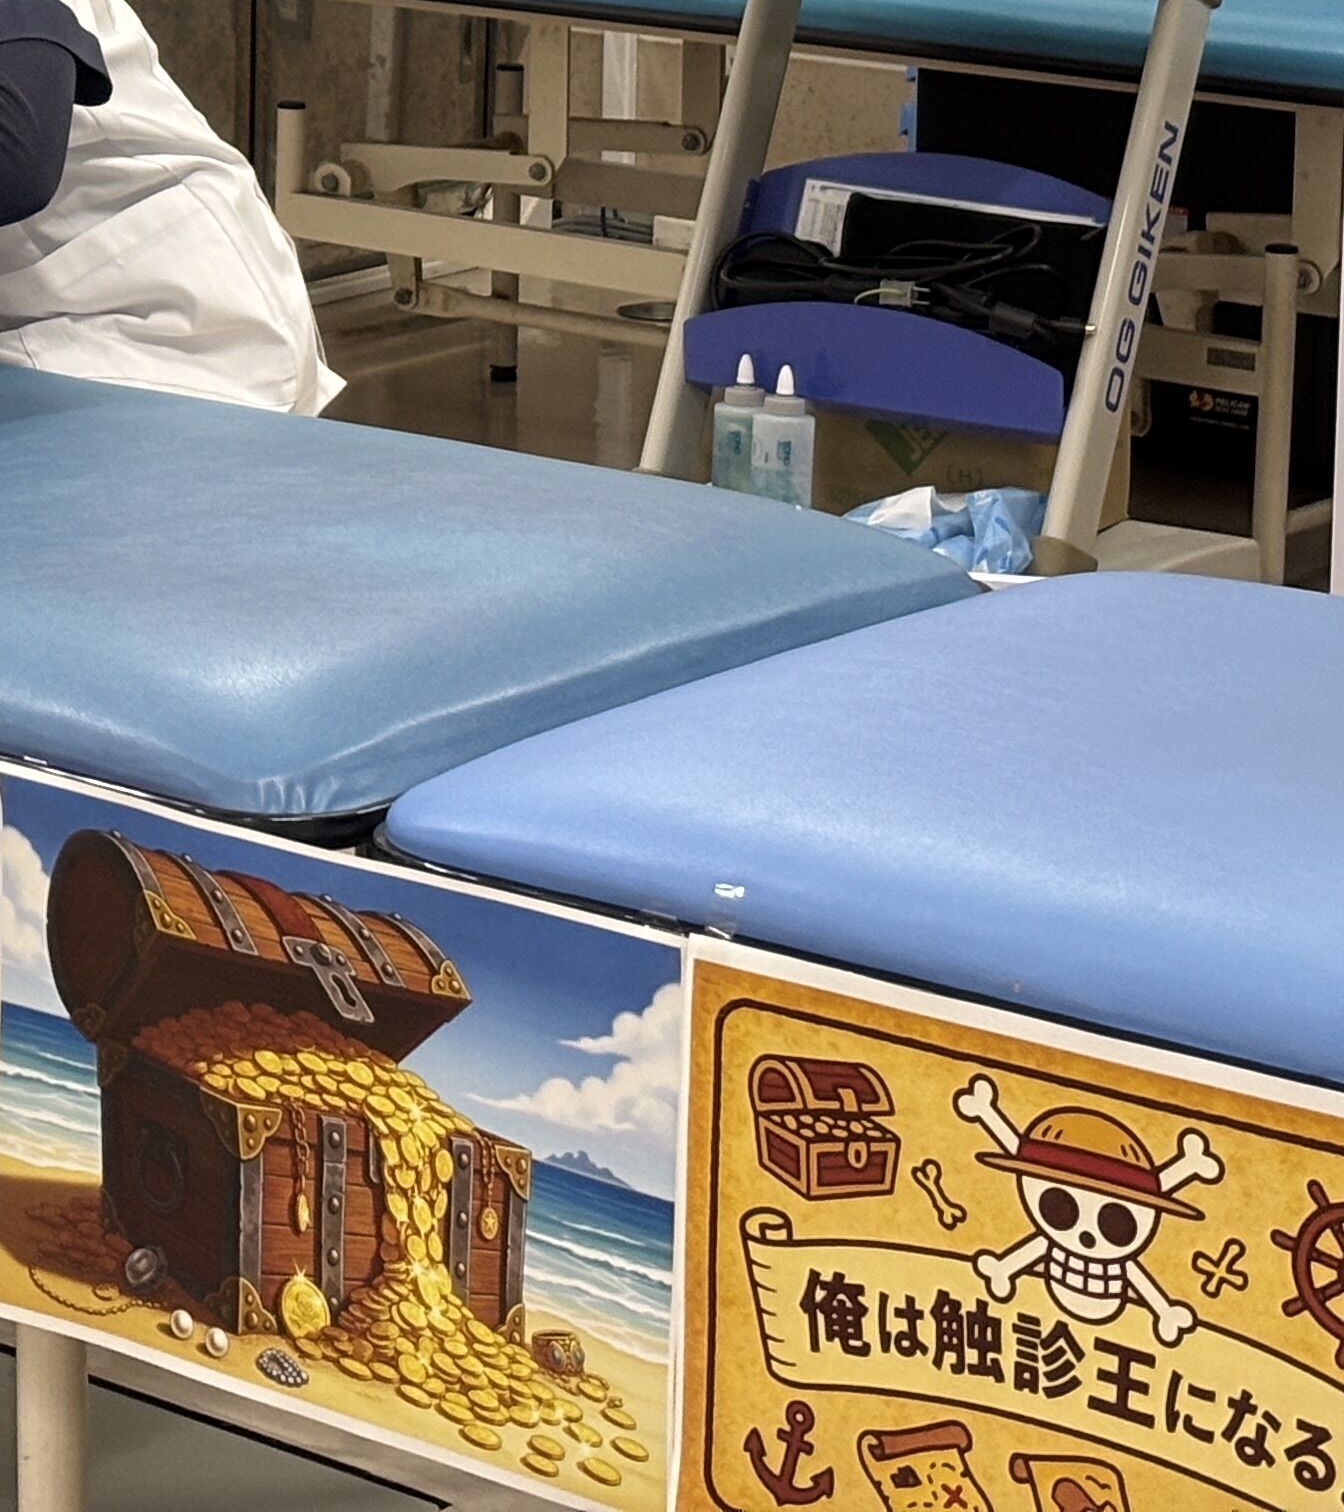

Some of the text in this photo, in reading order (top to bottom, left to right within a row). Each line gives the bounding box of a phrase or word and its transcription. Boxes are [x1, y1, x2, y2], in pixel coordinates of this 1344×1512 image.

[1104, 119, 1181, 414] OG GIKEN
[799, 1269, 1344, 1505] 俺は触診王になる
